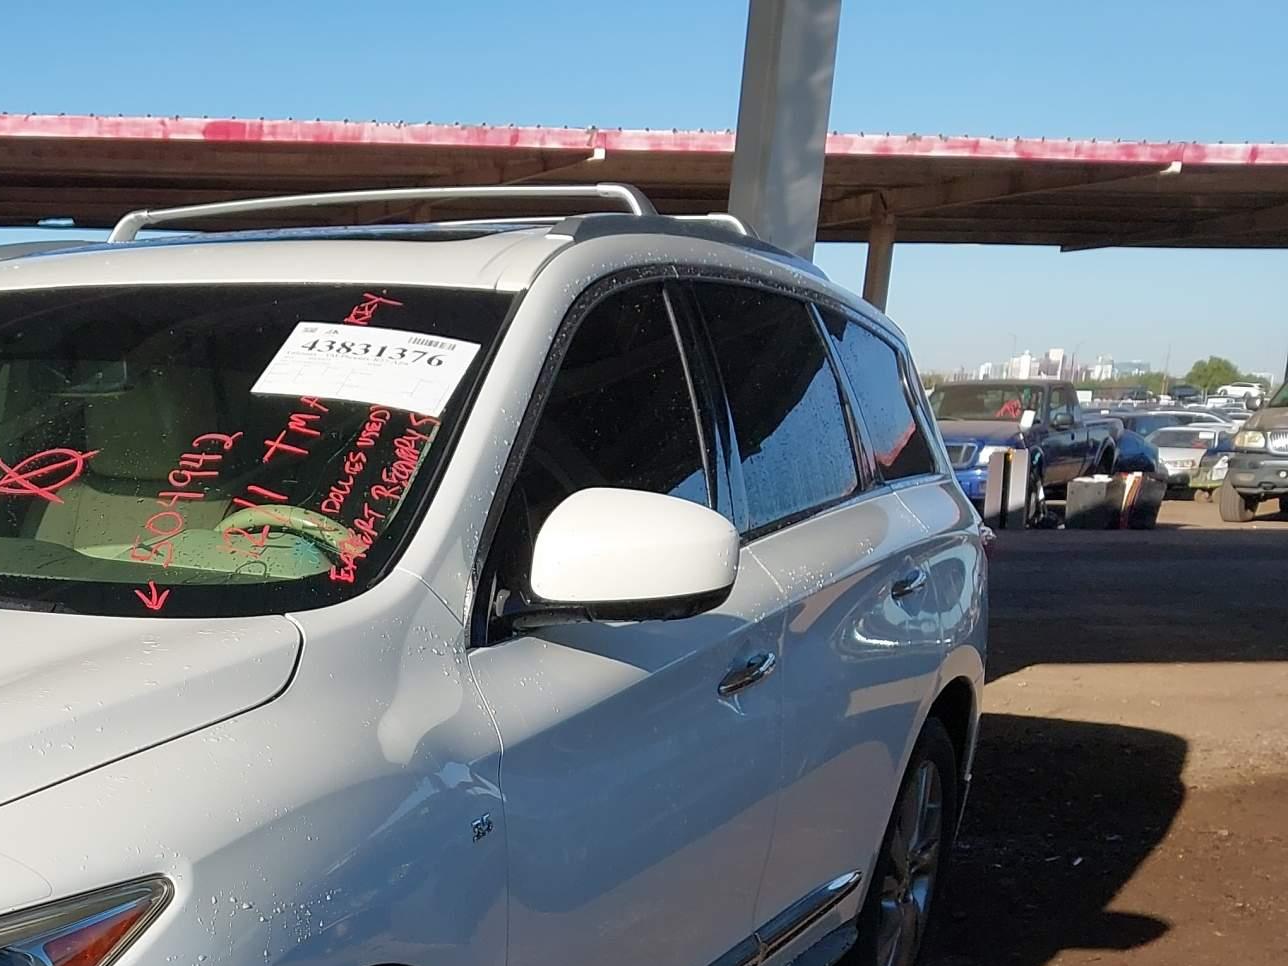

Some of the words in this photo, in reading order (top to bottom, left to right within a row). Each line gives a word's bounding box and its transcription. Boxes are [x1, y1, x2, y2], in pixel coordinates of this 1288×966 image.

[344, 293, 403, 325] KEY
[301, 338, 447, 367] 43831376
[356, 405, 391, 447] USED
[131, 432, 243, 568] 504942
